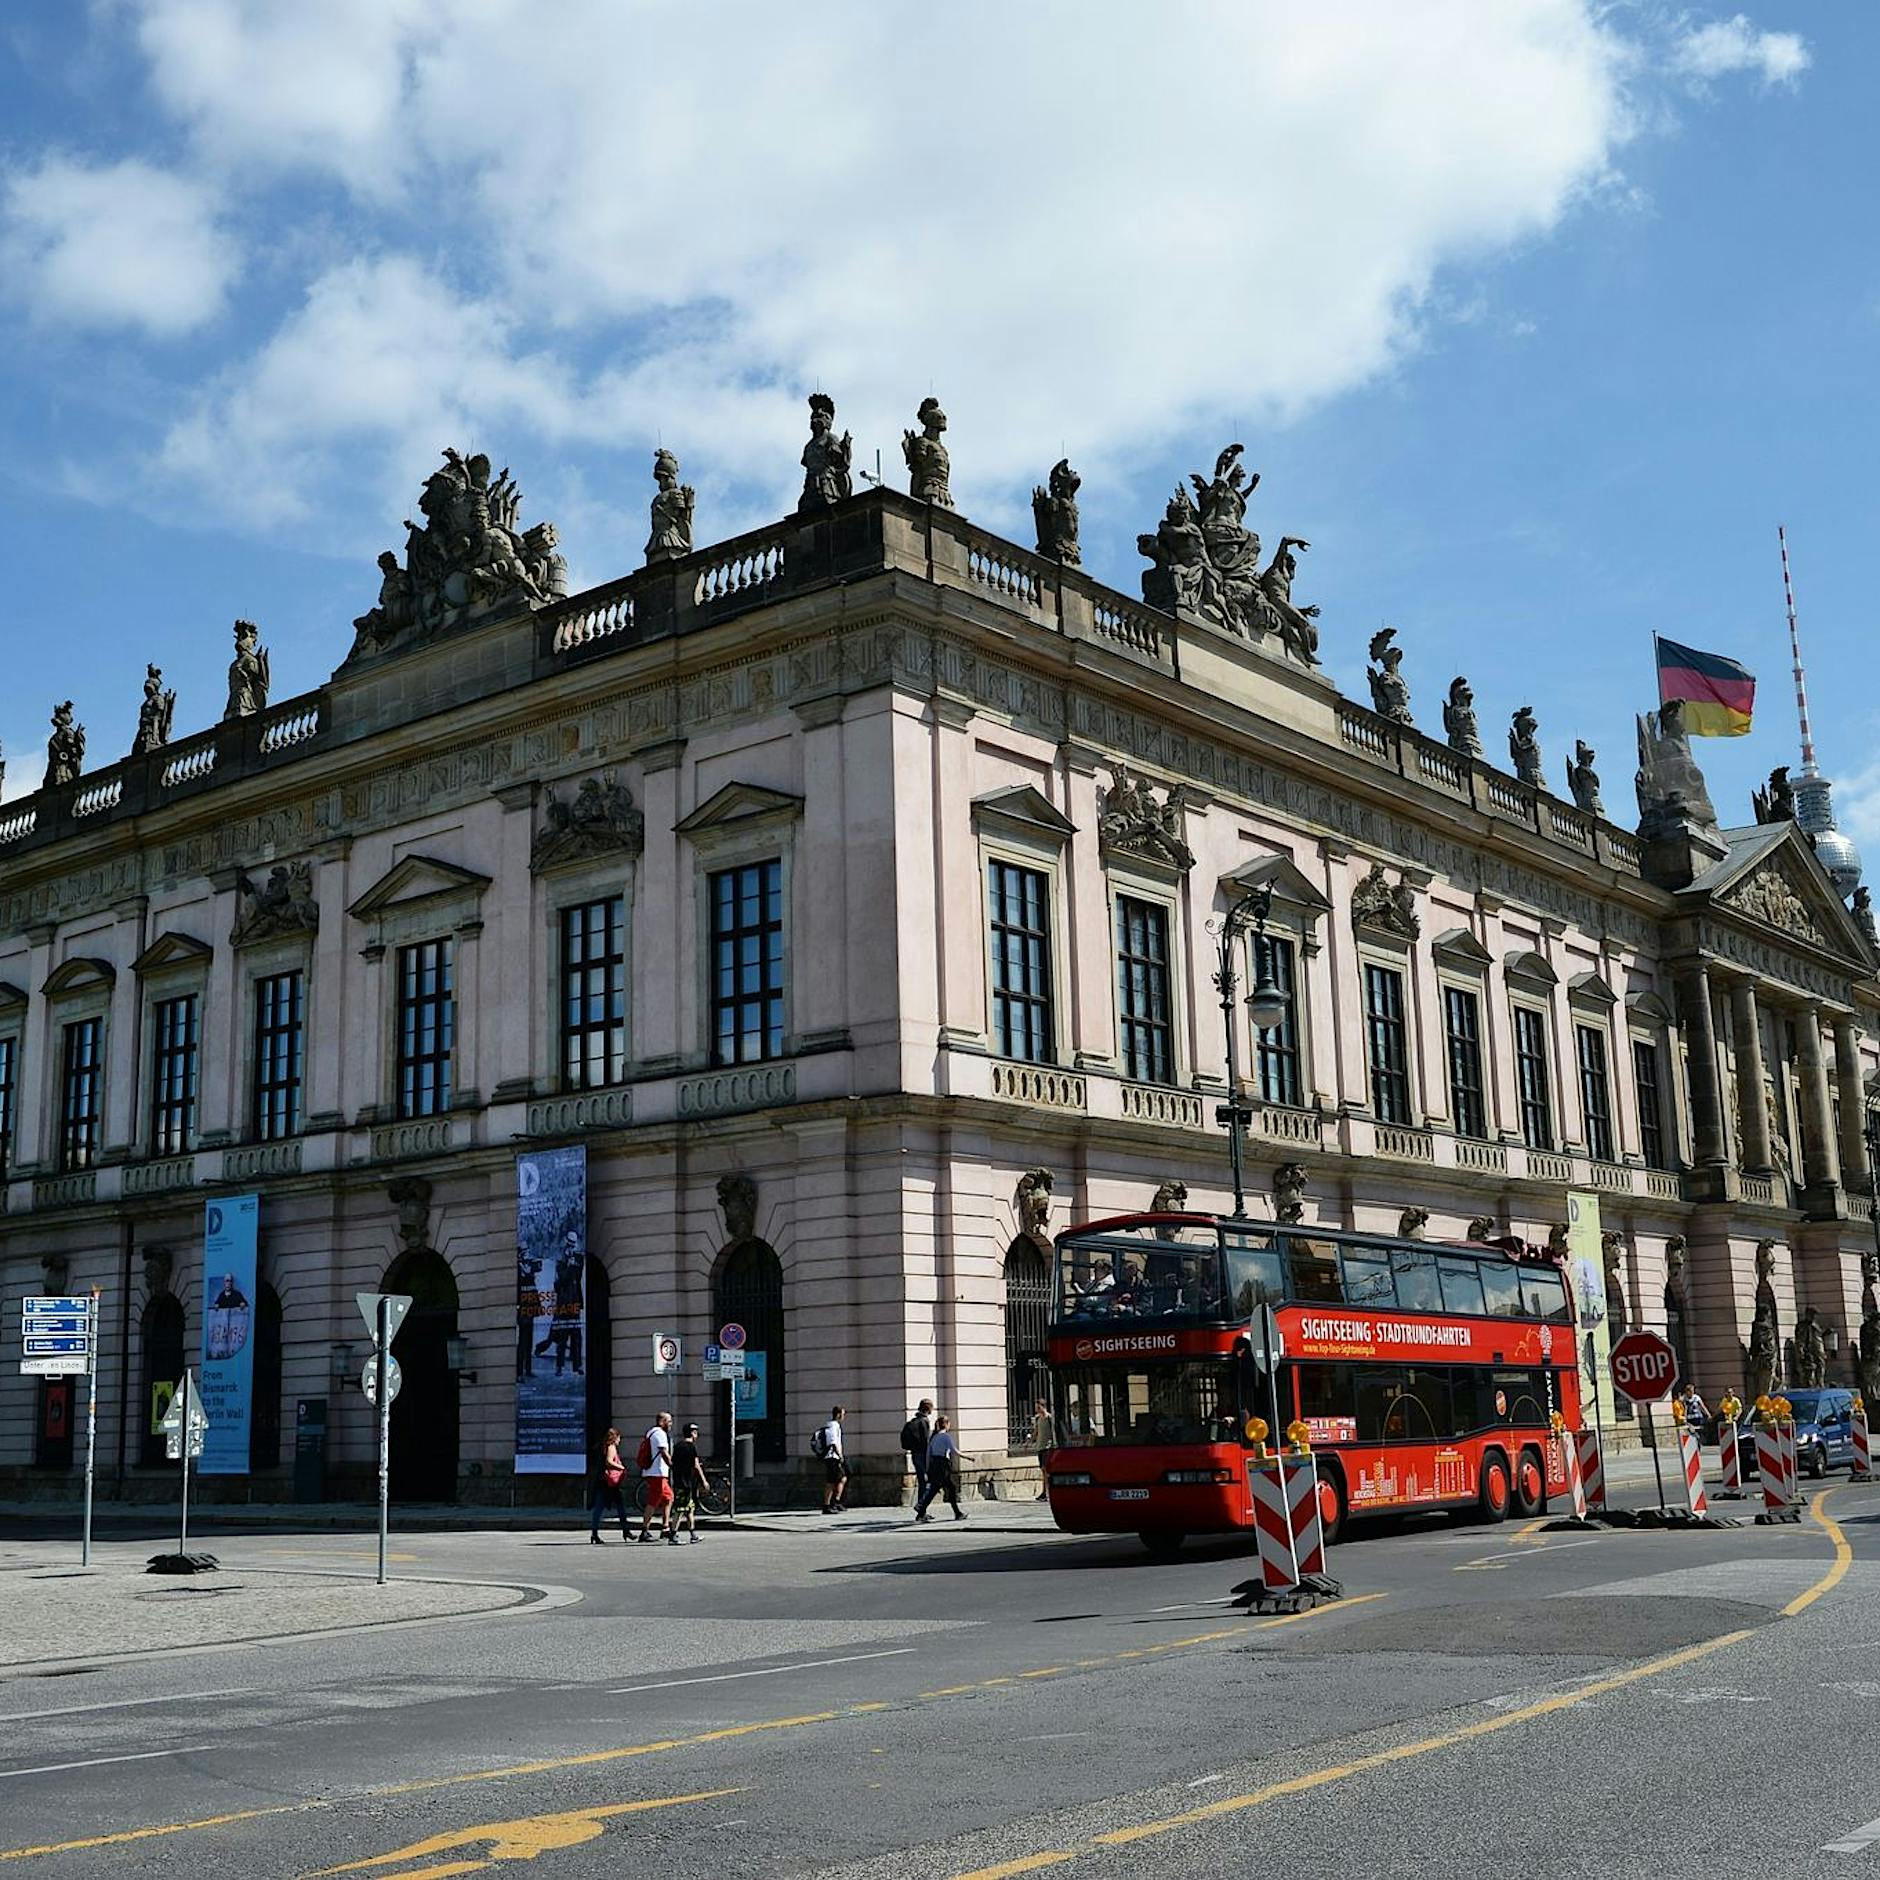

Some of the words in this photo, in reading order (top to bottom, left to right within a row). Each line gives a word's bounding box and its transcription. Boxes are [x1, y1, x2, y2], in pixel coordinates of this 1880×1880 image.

[520, 1162, 540, 1197] D
[1570, 1198, 1579, 1222] D
[208, 1206, 223, 1236] D
[1301, 1317, 1372, 1343] SIGHTSEEING
[1376, 1322, 1471, 1347] STADTRUNDFAHRTEN
[663, 1345, 675, 1356] 30
[1093, 1334, 1176, 1353] SIGHTSEEING
[708, 1347, 717, 1360] P
[202, 1370, 223, 1380] From
[1615, 1350, 1671, 1384] STOP
[202, 1382, 239, 1393] Bismarck
[212, 1396, 225, 1406] the
[226, 1407, 244, 1419] Wall
